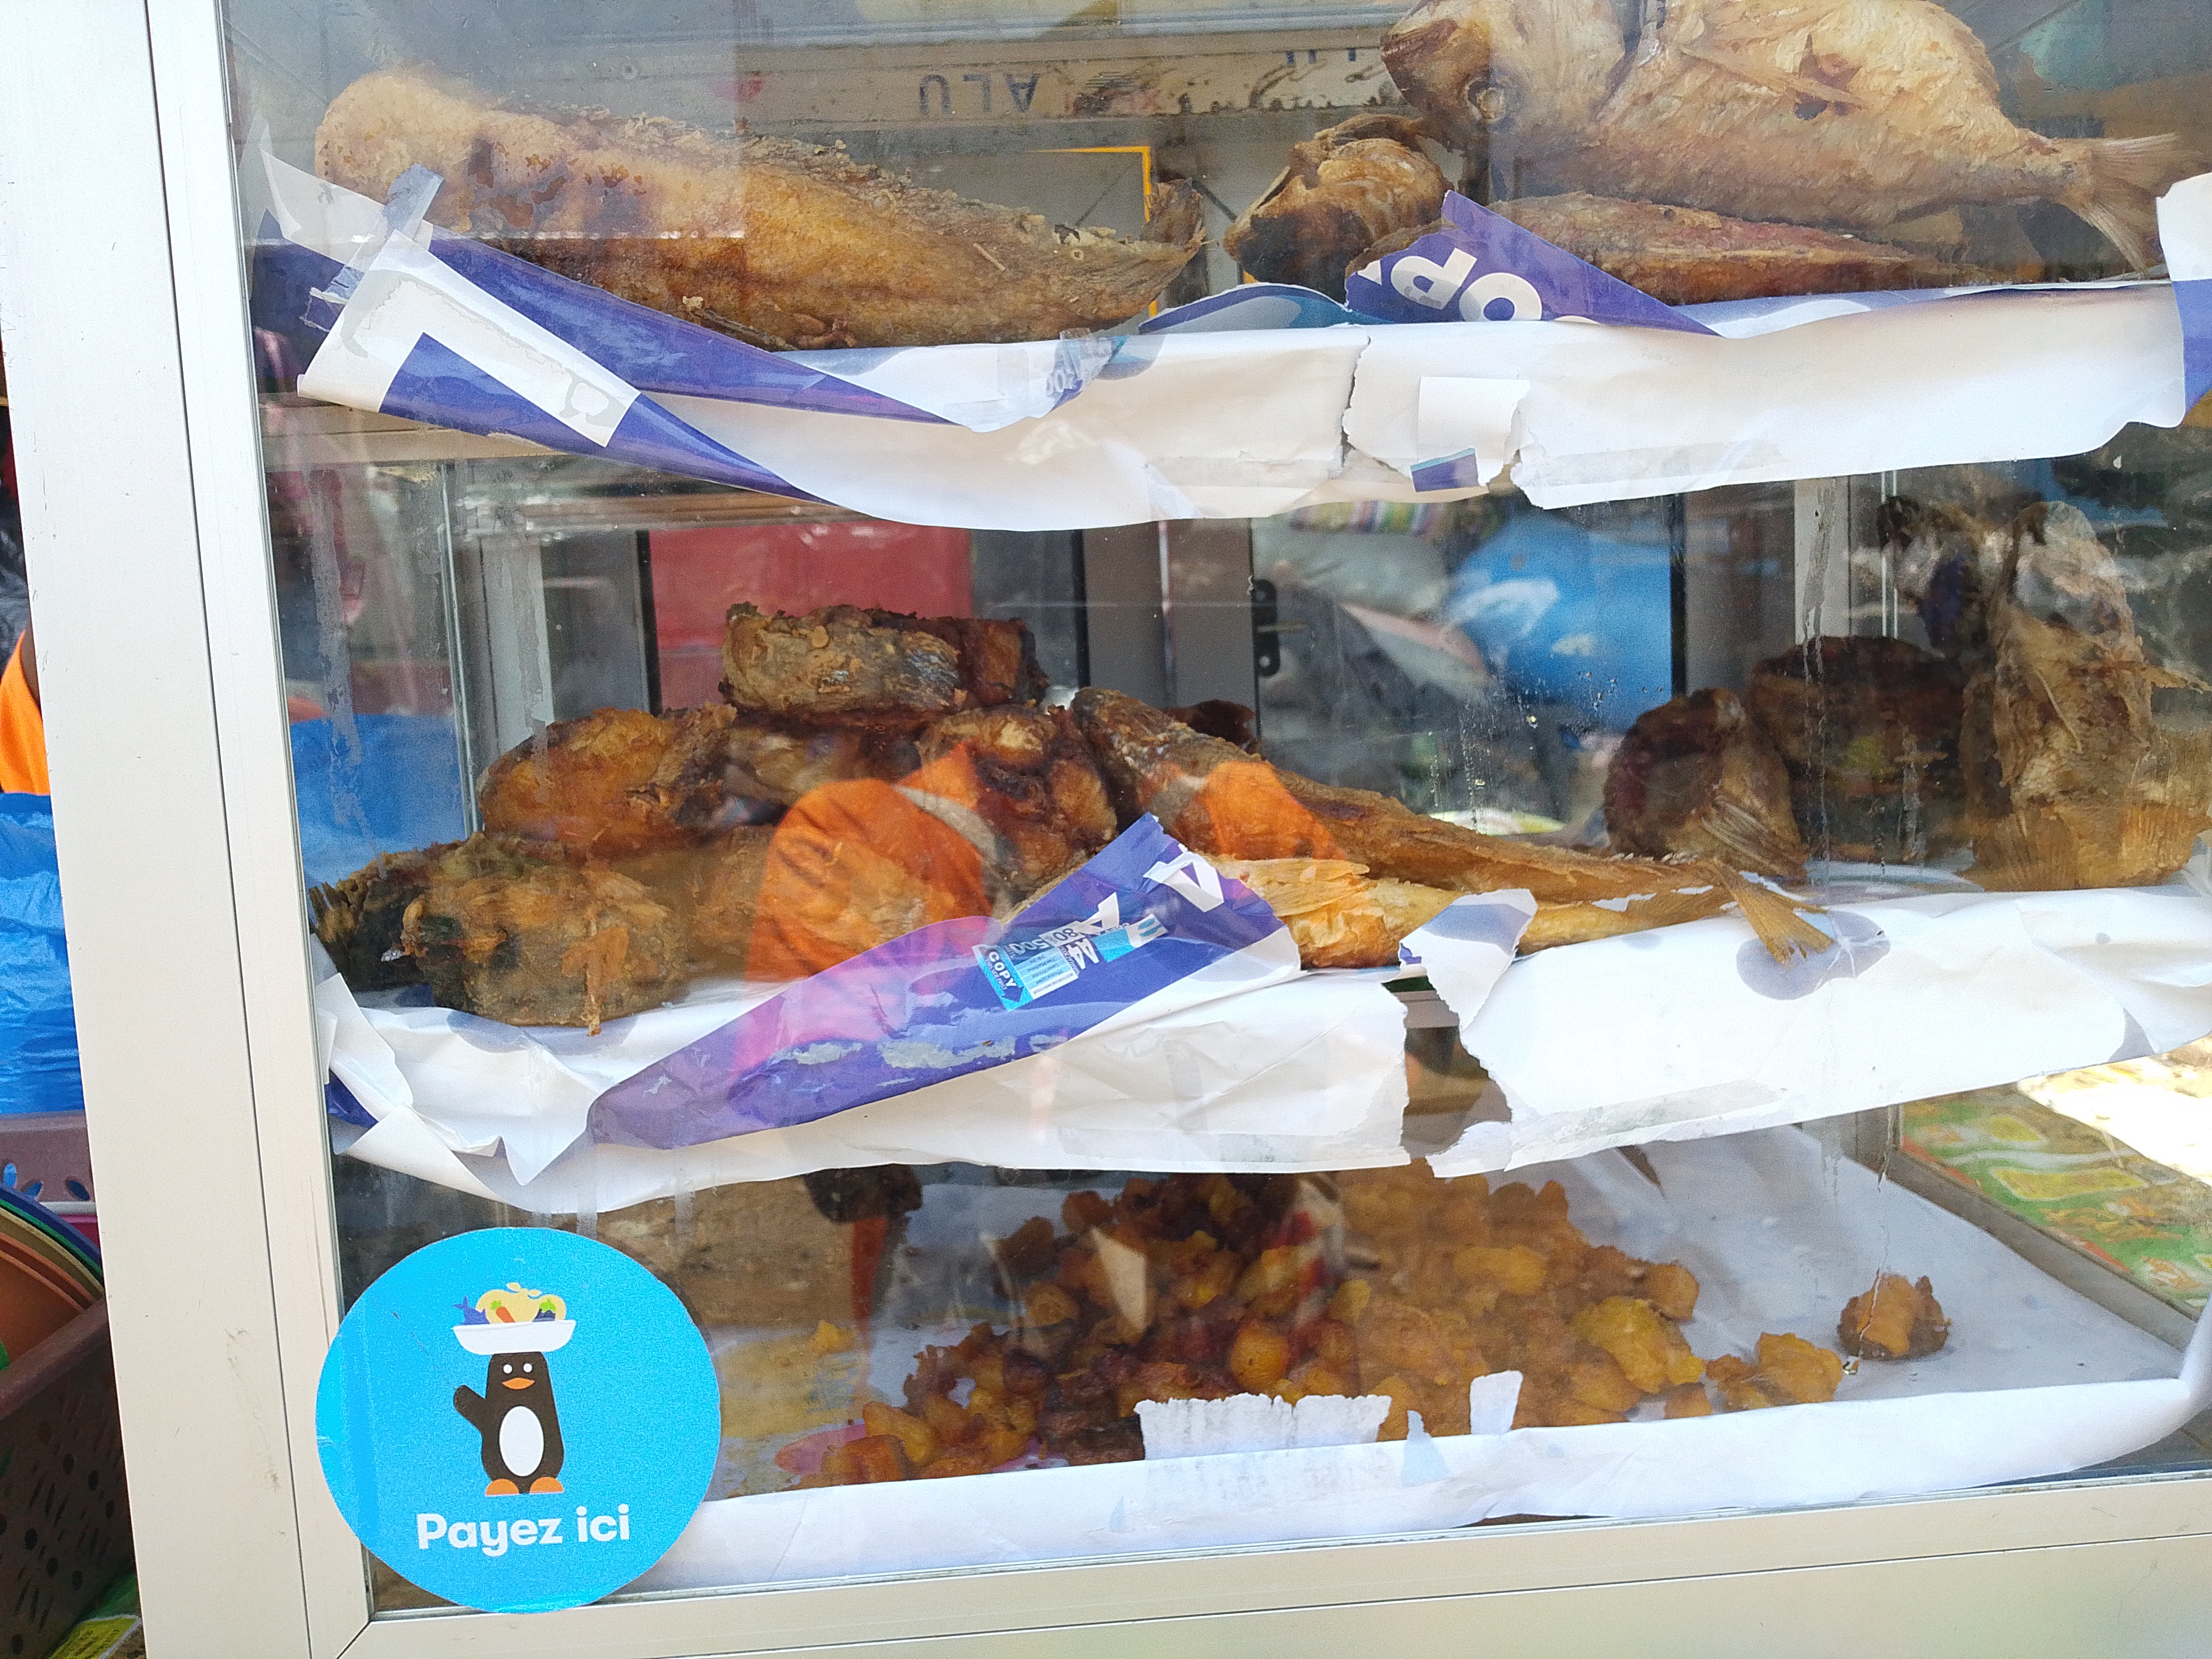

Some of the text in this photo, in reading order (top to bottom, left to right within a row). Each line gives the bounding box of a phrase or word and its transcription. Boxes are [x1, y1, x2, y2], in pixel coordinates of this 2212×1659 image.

[1008, 939, 1050, 954] 500
[1052, 928, 1079, 942] 80
[988, 951, 1017, 987] COPY
[1067, 938, 1100, 969] A4
[417, 1503, 630, 1557] Payez ici
